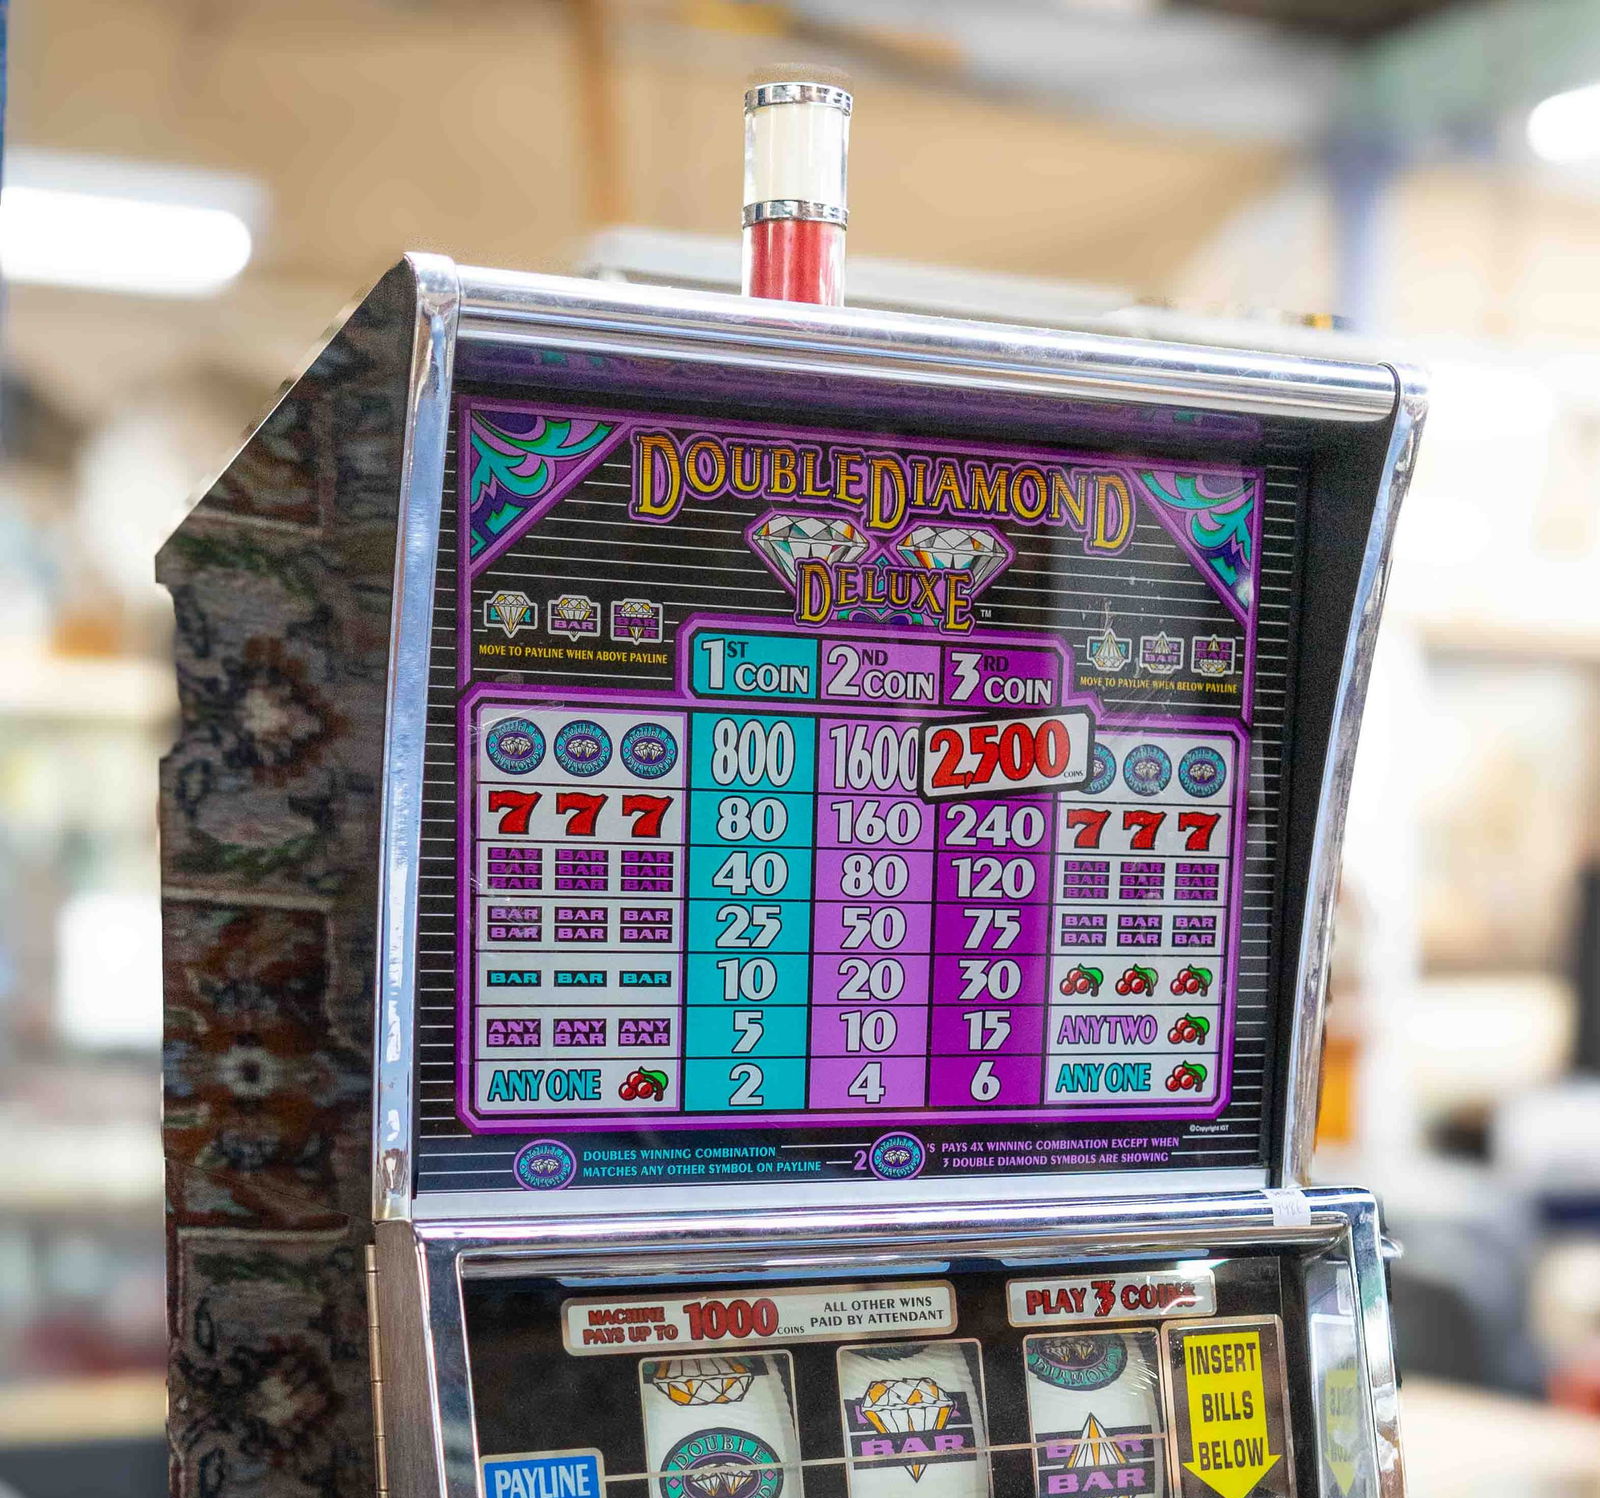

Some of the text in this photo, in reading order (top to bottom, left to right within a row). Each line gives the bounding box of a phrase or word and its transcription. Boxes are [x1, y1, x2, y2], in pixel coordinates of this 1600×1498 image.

[632, 431, 1133, 550] DOUBLE DIAMOND
[798, 562, 974, 631] DELUXE
[479, 645, 667, 664] MOVE TO PAYLINE WHEN ABOVE PAYLINE
[735, 663, 809, 693] COIN
[862, 671, 935, 700] COIN
[983, 678, 1052, 705] COIN
[1080, 676, 1237, 693] MOVE TO PAYLINE WHEN BELOW PAYLINE
[712, 718, 796, 787] 800
[830, 725, 919, 792] 1600
[1064, 770, 1083, 778] COINS
[716, 796, 788, 841] 80
[832, 801, 921, 844] 160
[946, 804, 1045, 847] 240
[713, 851, 788, 895] 40
[841, 854, 908, 897] 80
[951, 857, 1036, 898] 120
[716, 905, 782, 948] 25
[841, 907, 907, 949] 50
[963, 909, 1021, 949] 75
[491, 973, 537, 984] BAR
[717, 958, 777, 1001] 10
[958, 959, 1022, 1000] 30
[1057, 1015, 1158, 1044] ANY TWO
[488, 1069, 601, 1101] ANY ONE
[1056, 1063, 1152, 1092] ANY ONE
[583, 1147, 776, 1161] DOUBLES WINNING COMBINATION
[583, 1161, 821, 1177] MATCHES ANY OTHER SYMBOL ON PAYLINE
[854, 1137, 1179, 1170] 2 PAYS 4X WINNING COMBINATION EXCEPT WHEN
[943, 1152, 1169, 1167] 3 DOUBLE DIAMOND SYMBOLS ARE SHOWING
[824, 1296, 932, 1312] ALL OTHER WINS
[1026, 1287, 1086, 1315] PLAY
[1091, 1280, 1116, 1316] 3
[583, 1298, 805, 1345] PAYS UP TO 1000 COINS
[588, 1306, 665, 1326] MACHINE
[810, 1309, 944, 1328] PAID BY ATTENDANT
[1189, 1342, 1256, 1375] INSERT
[1202, 1390, 1254, 1423] BILLS
[672, 1434, 768, 1469] DOUBLE
[861, 1435, 965, 1458] BAR
[1198, 1437, 1263, 1471] BELOW
[1048, 1468, 1146, 1495] BAR
